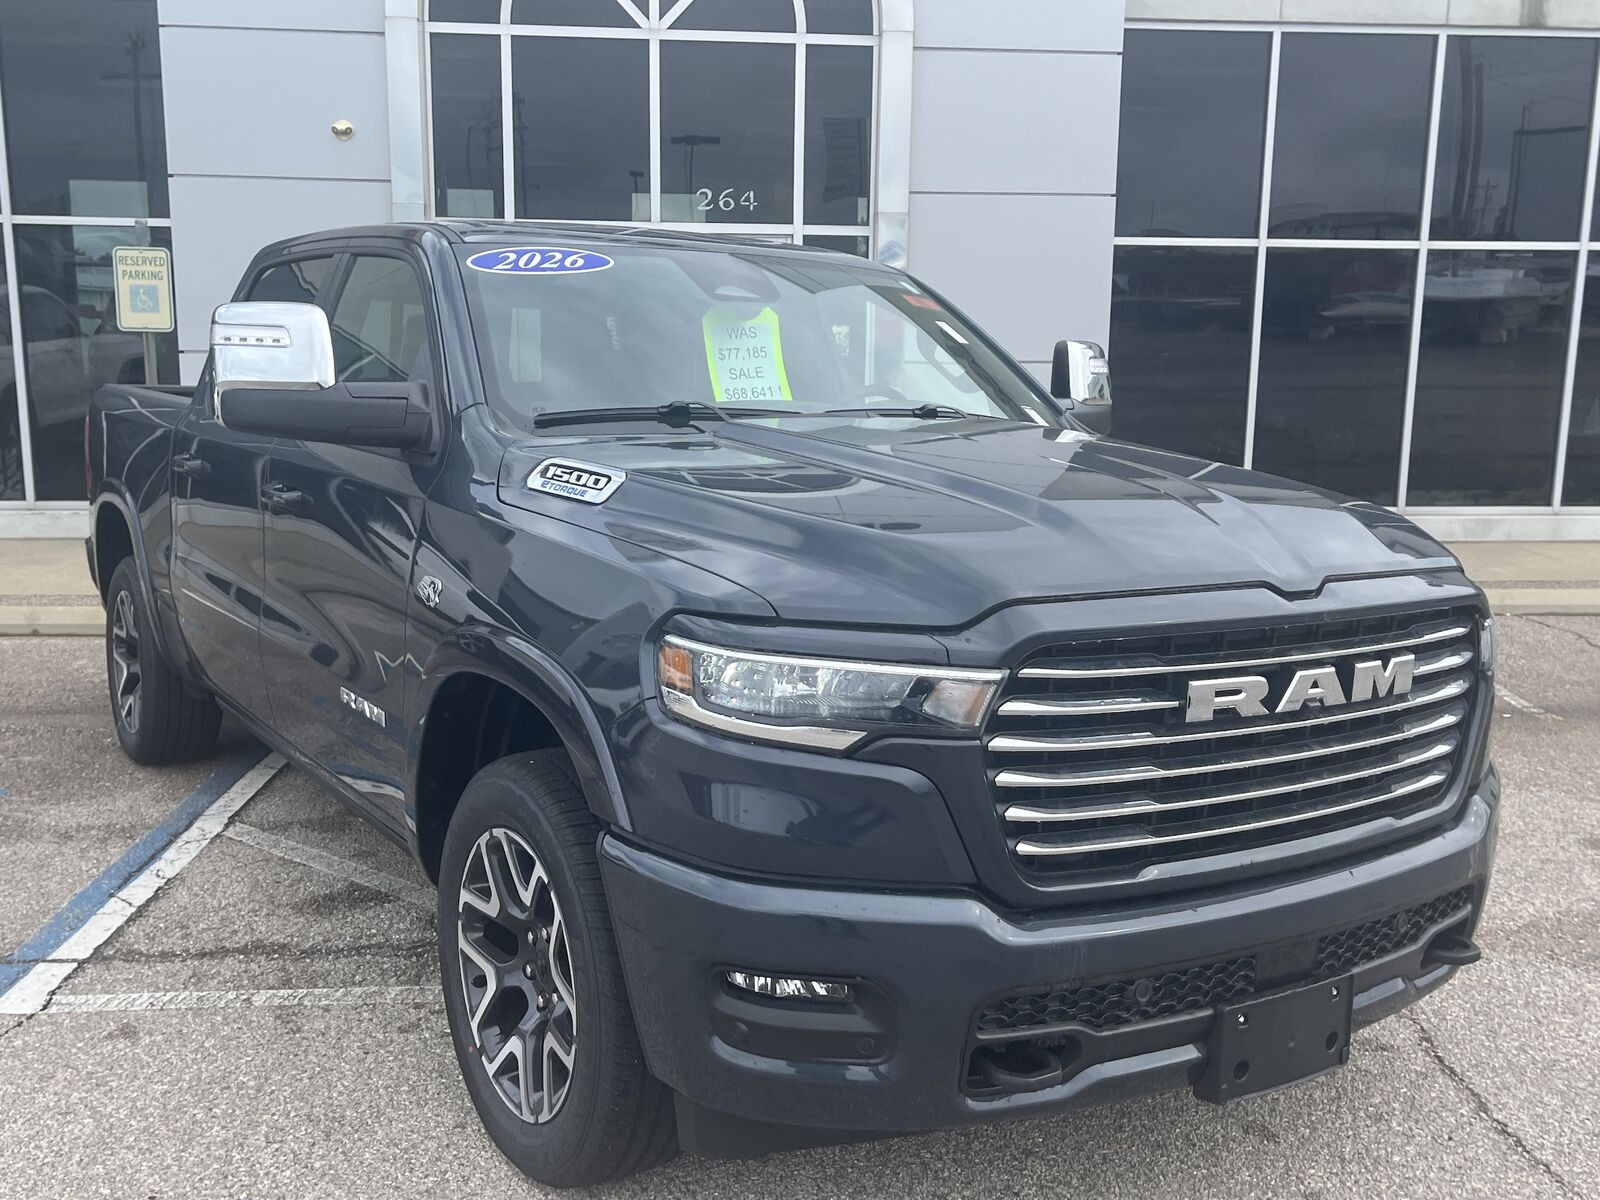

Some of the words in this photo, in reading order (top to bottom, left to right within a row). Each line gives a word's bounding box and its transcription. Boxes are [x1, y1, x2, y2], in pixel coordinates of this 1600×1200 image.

[696, 188, 758, 212] 264
[118, 255, 165, 267] RESERVED
[493, 251, 585, 270] 2026
[122, 269, 164, 281] PARKING
[726, 326, 757, 339] WAS
[717, 346, 767, 362] $77,185
[728, 366, 764, 380] SALE
[545, 465, 608, 490] 1500
[1185, 654, 1415, 722] RAM
